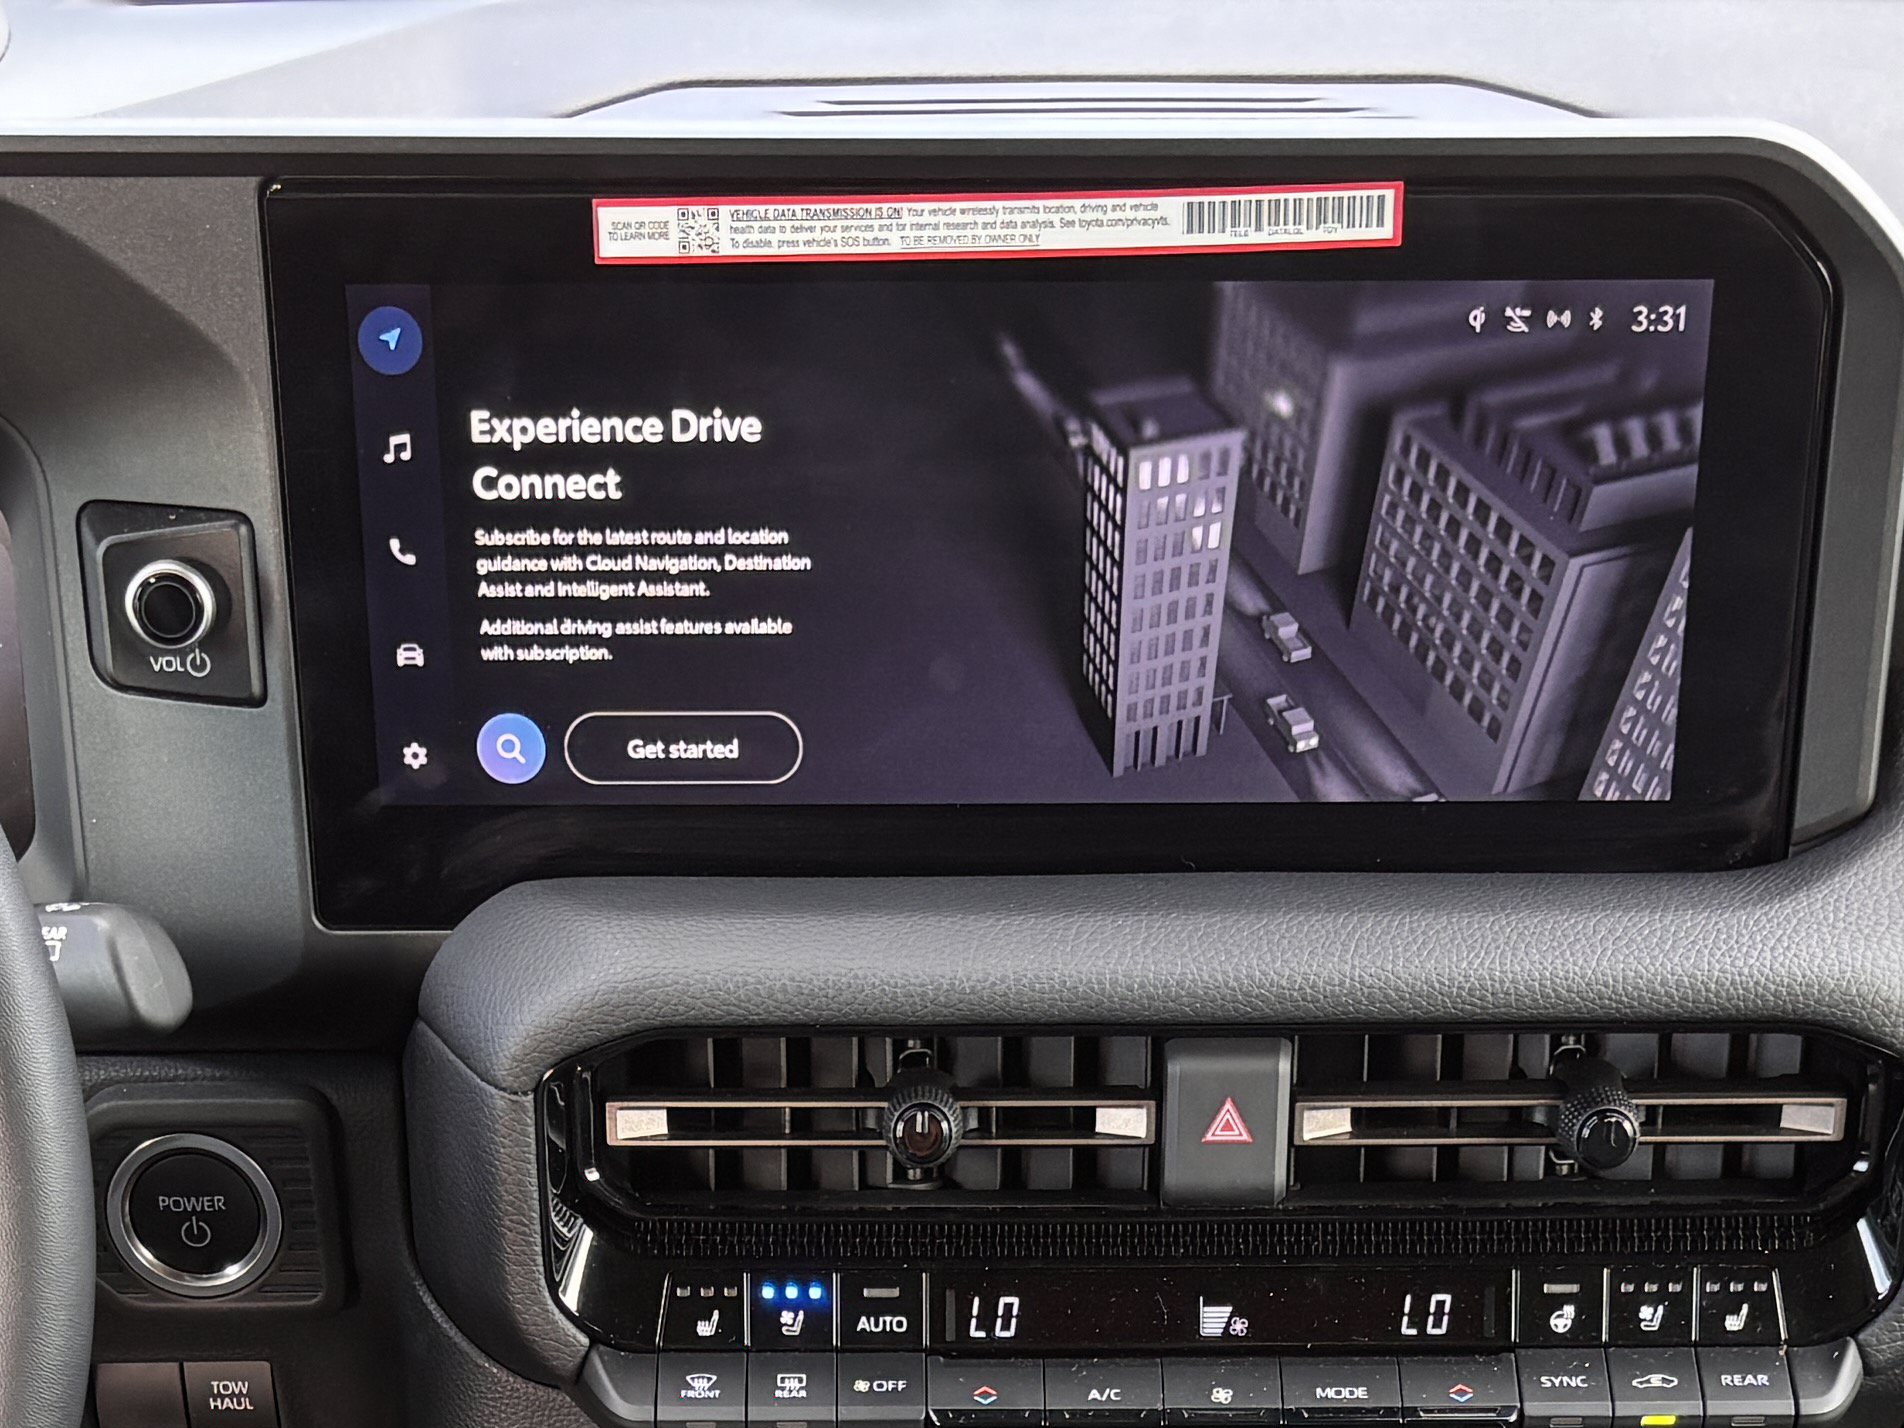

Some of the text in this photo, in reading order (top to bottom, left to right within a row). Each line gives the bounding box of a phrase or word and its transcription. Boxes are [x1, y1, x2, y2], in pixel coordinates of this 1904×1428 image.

[730, 208, 770, 220] VEHICLE
[774, 208, 796, 220] DATA
[801, 207, 872, 219] TRANSMISSION
[907, 208, 924, 217] Your
[928, 207, 956, 216] vehicle
[960, 206, 999, 217] wirelessly
[1002, 205, 1039, 215] transmits
[1080, 203, 1107, 215] driving
[1112, 203, 1126, 213] and
[1130, 202, 1158, 212] vehicle
[611, 221, 633, 230] SCAN
[648, 220, 669, 230] CODE
[608, 231, 669, 240] TO LEARN MORE
[730, 238, 739, 248] To
[778, 238, 799, 249] press
[840, 237, 860, 247] SOS
[900, 237, 910, 246] TO
[913, 237, 924, 246] BE
[927, 235, 968, 246] REMOVED
[971, 235, 982, 245] BY
[985, 234, 1015, 244] OWNER
[1019, 233, 1040, 244] ONLY
[1631, 305, 1686, 333] 3:31
[470, 407, 762, 451] Experience Drive
[472, 466, 623, 500] Connect
[475, 527, 788, 546] Subscribe for the latest route and location
[476, 553, 811, 575] guidance with Cloud Navigation, Destination
[477, 579, 711, 600] Assist and Intelligent Assistant.
[479, 616, 793, 638] Additional driving assist features available
[480, 644, 613, 664] with subscription.
[150, 655, 184, 672] VOL
[627, 738, 739, 759] Get started
[42, 926, 67, 940] EAR
[158, 1196, 226, 1212] POWER
[856, 1316, 908, 1333] AUTO
[211, 1381, 248, 1395] TOW
[872, 1379, 907, 1393] OFF
[1540, 1375, 1588, 1389] SYNC
[1720, 1374, 1770, 1388] REAR
[680, 1388, 720, 1399] FRONT
[774, 1388, 807, 1399] REAR
[1088, 1388, 1121, 1402] A/C
[1315, 1386, 1368, 1400] MODE
[209, 1397, 254, 1411] HAUL
